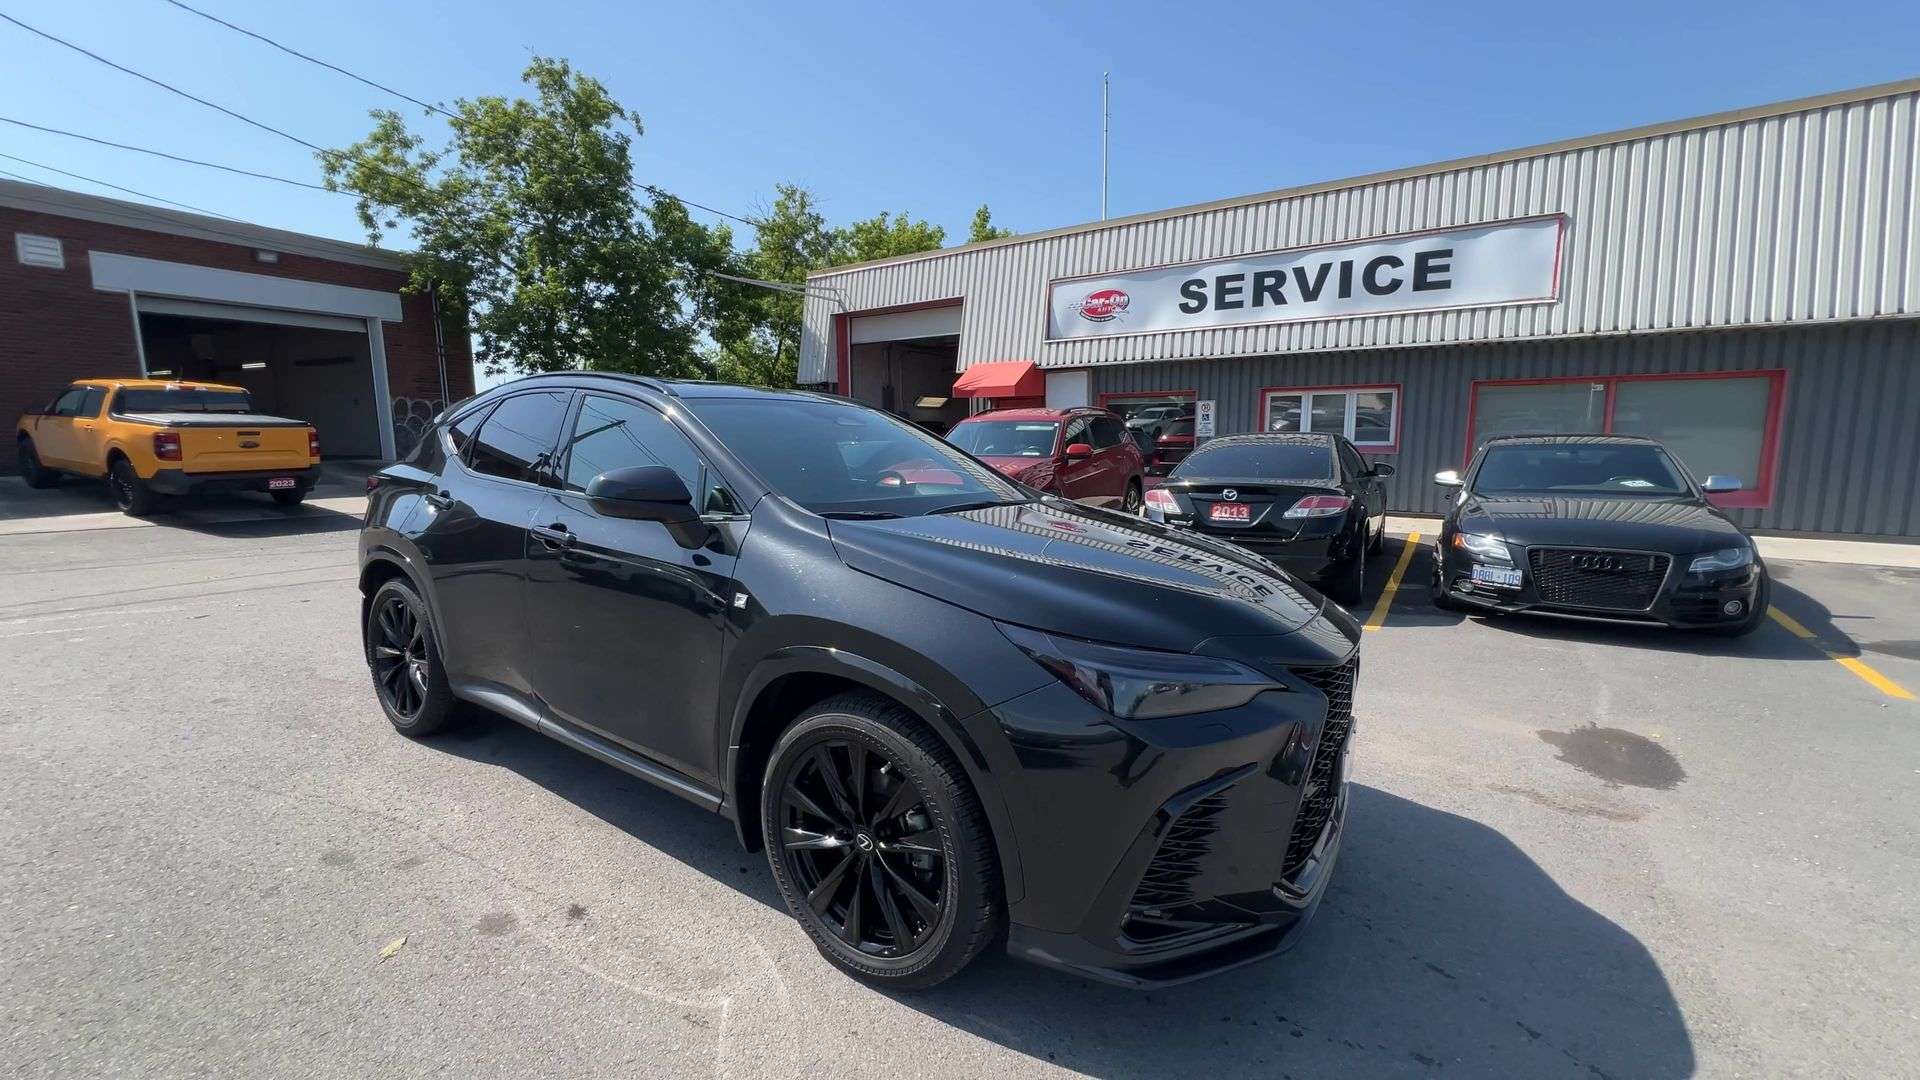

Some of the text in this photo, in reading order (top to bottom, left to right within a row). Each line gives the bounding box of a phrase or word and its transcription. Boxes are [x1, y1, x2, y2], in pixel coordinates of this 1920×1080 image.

[1178, 249, 1453, 314] SERVICE
[269, 480, 295, 488] 2023
[1212, 505, 1248, 518] 2013
